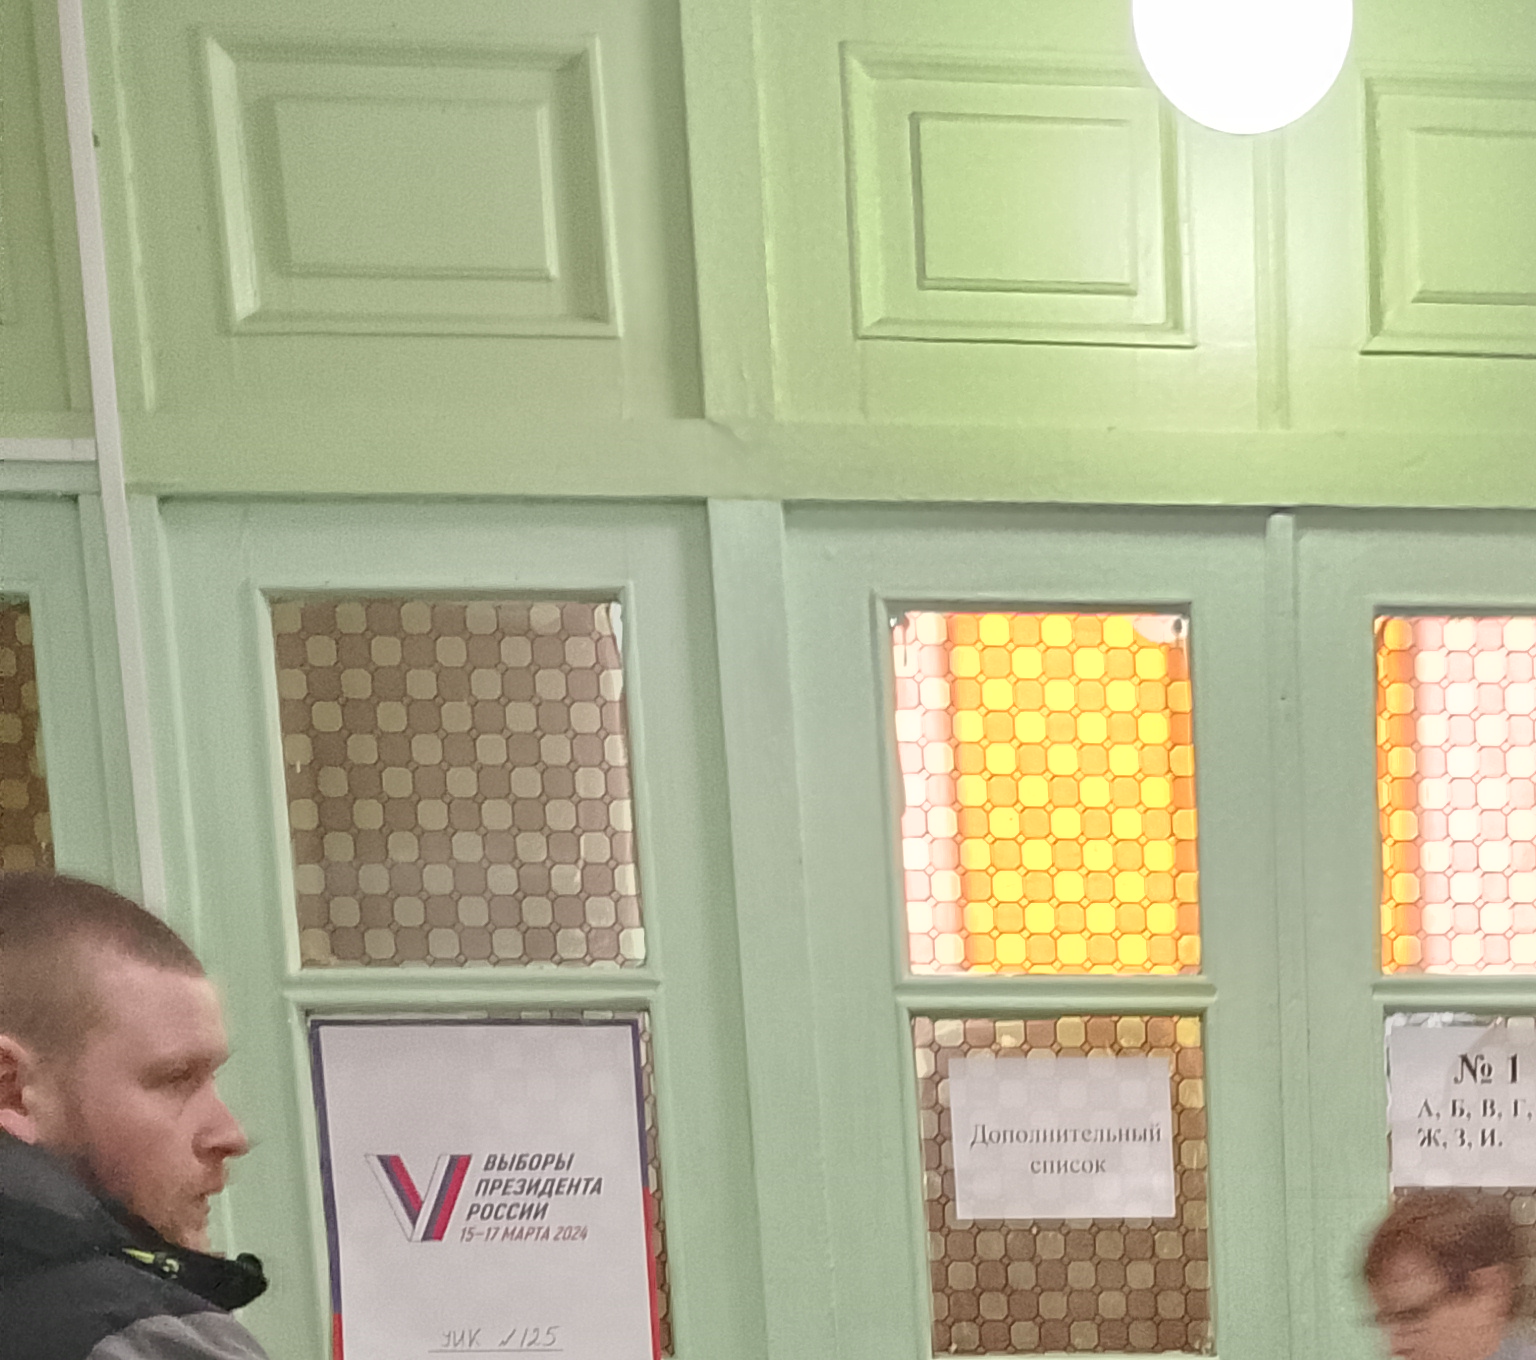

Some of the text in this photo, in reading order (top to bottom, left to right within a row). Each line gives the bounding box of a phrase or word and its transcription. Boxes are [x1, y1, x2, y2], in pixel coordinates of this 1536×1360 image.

[1508, 1053, 1518, 1084] 1
[970, 1122, 1162, 1149] Дополнительный
[483, 1153, 575, 1171] ВЫБОРЫ
[1030, 1158, 1106, 1175] список
[475, 1177, 603, 1199] ПРЕЗИДЕНТА
[466, 1202, 549, 1221] РОССИИ
[501, 1225, 550, 1242] МАРТА
[553, 1225, 588, 1241] 2024
